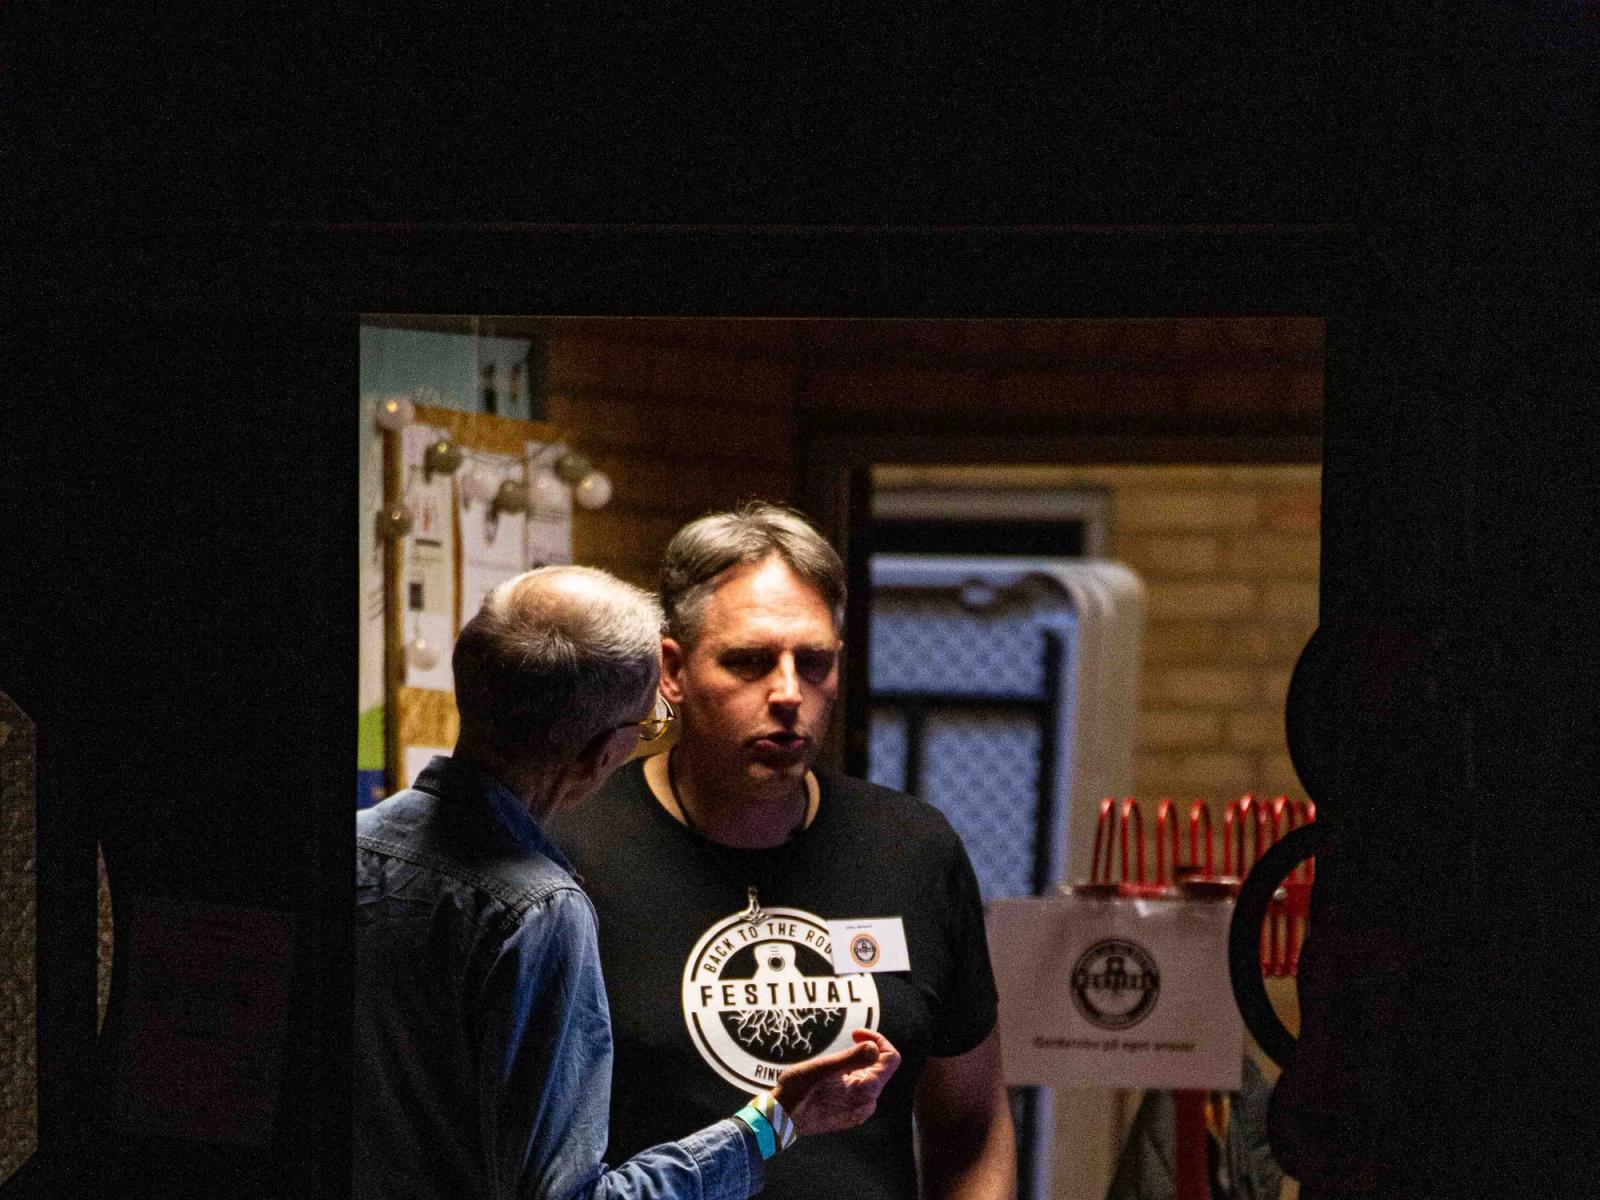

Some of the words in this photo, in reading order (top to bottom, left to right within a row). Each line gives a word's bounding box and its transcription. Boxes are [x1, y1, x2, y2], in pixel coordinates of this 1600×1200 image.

[703, 938, 736, 973] BACK
[738, 926, 758, 942] TO
[767, 923, 798, 938] THE
[805, 930, 832, 955] ROO
[700, 980, 862, 1007] FESTIVAL
[754, 1064, 783, 1082] RINK
